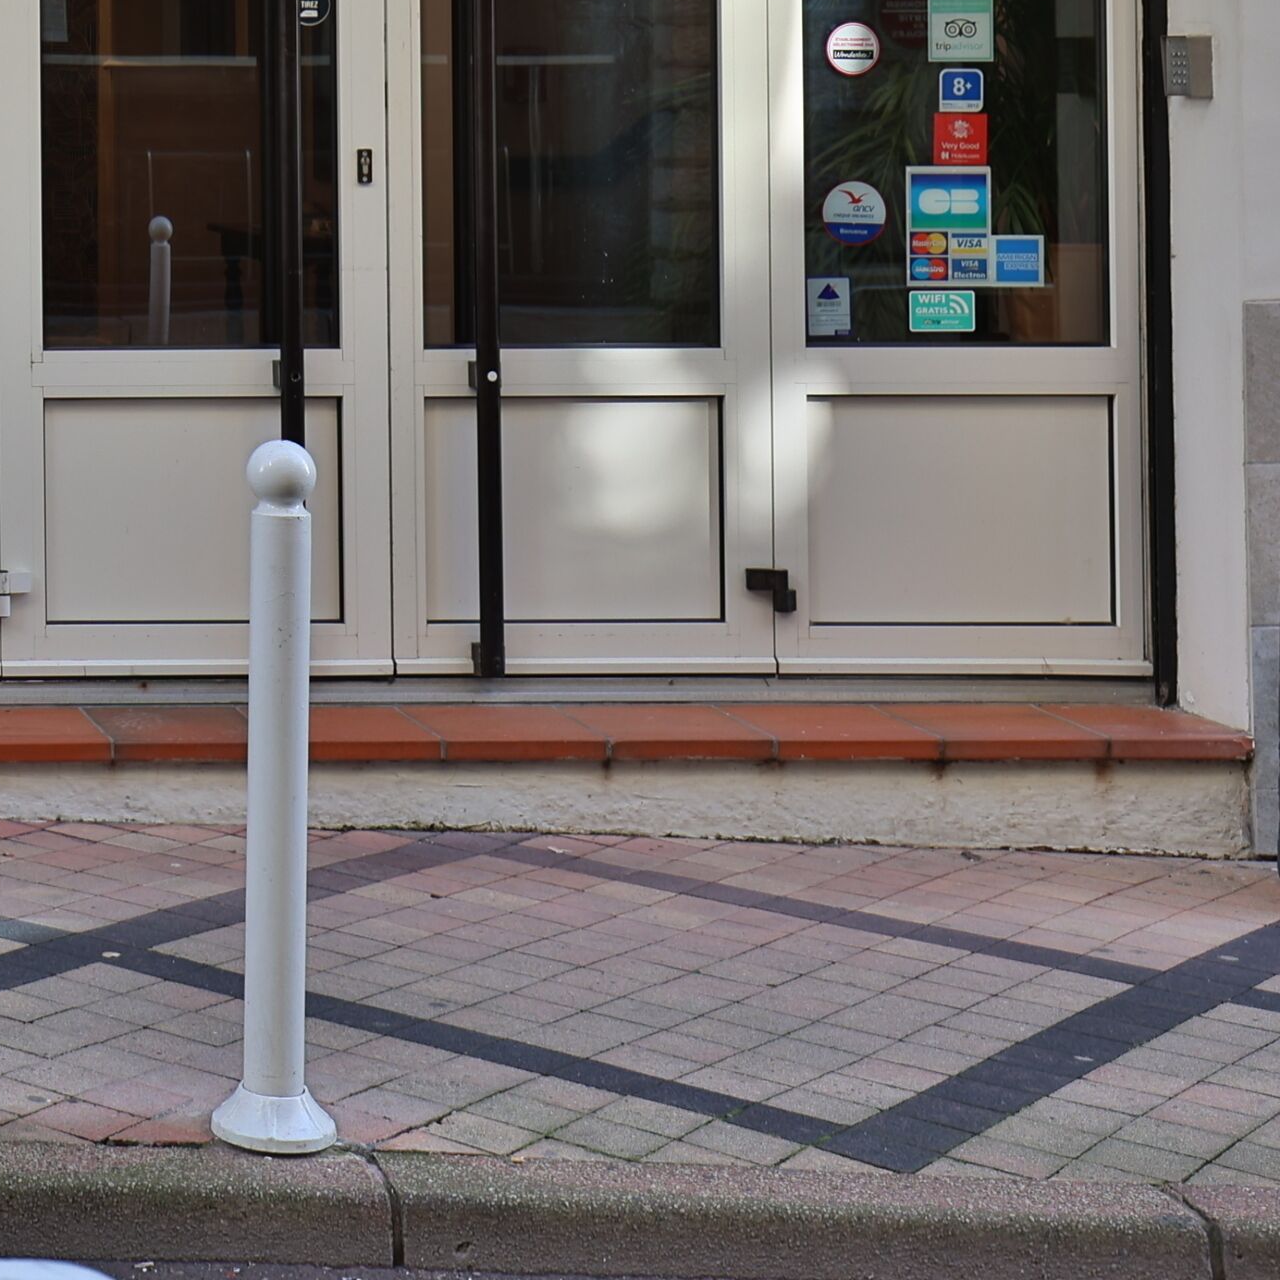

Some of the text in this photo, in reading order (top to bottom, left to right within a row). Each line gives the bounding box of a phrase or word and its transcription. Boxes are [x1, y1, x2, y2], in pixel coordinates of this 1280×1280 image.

[300, 0, 318, 9] TIREZ
[941, 142, 980, 151] Very Good
[918, 188, 980, 215] CB
[852, 204, 875, 213] ancv
[957, 238, 982, 248] VISA
[997, 253, 1038, 261] AMERICAN
[954, 271, 986, 279] Electron
[918, 294, 946, 303] WIFI
[915, 306, 948, 314] GRATIS
